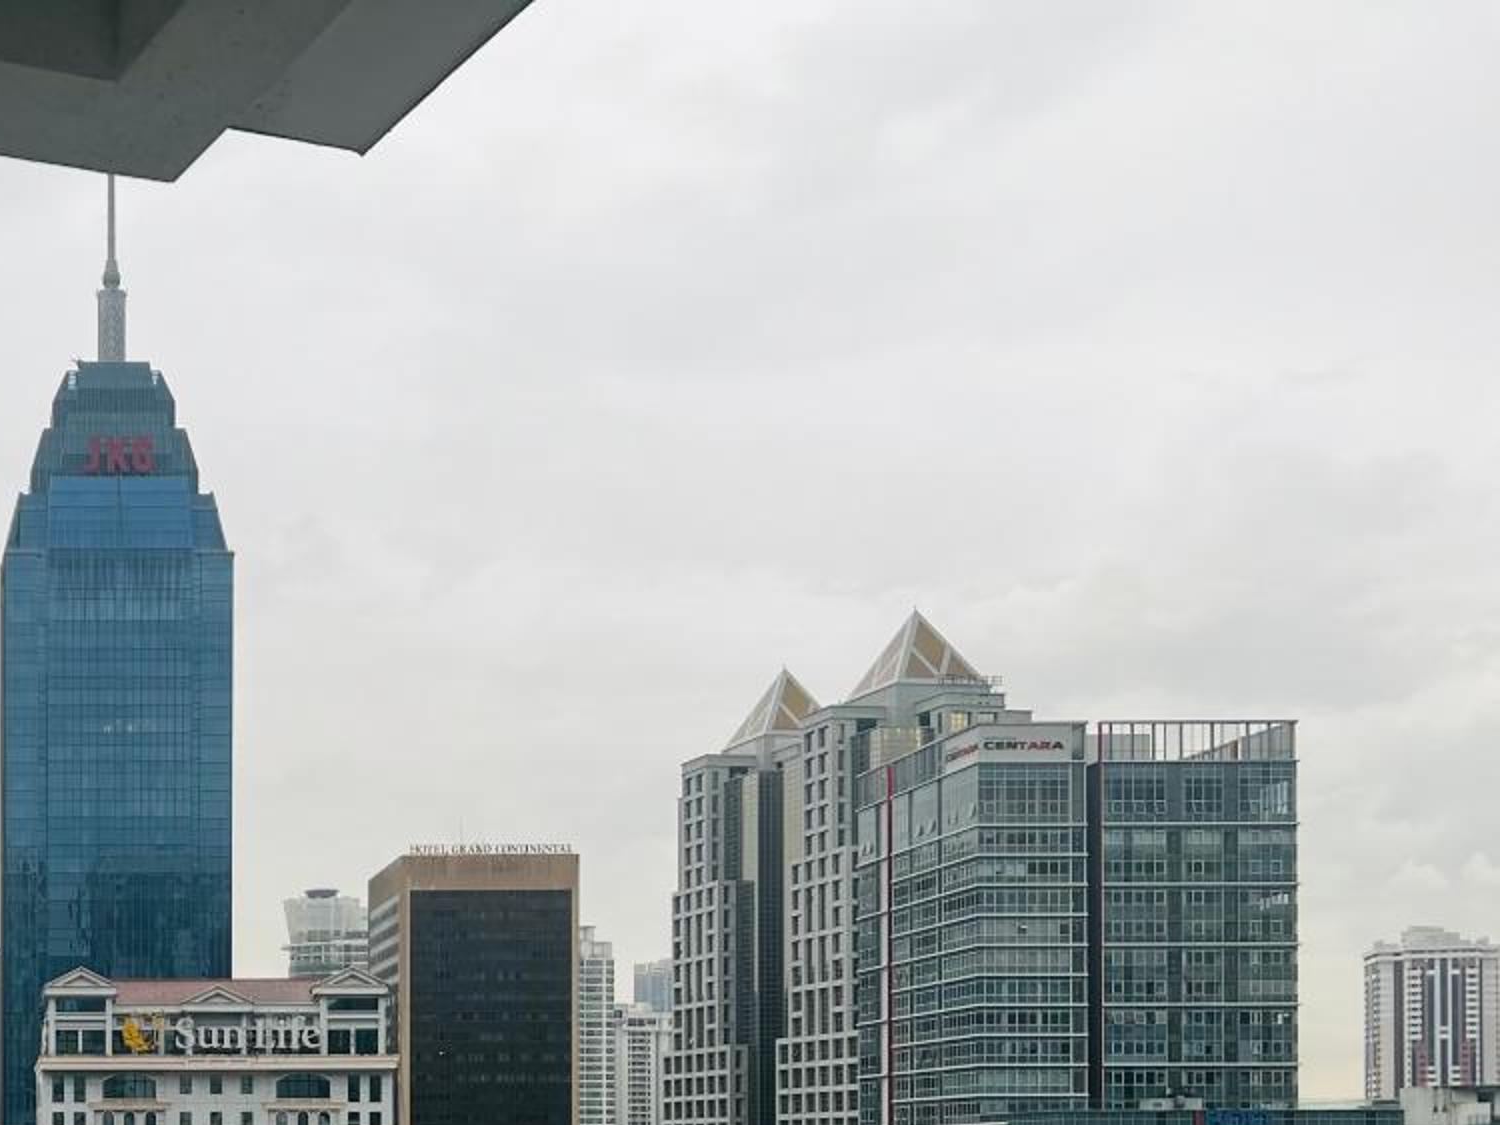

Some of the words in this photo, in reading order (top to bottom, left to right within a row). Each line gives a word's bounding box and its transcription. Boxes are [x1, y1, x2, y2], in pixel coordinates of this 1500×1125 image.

[983, 741, 1064, 751] CENTARA
[175, 1015, 247, 1049] Sun
[254, 1014, 322, 1050] Life
